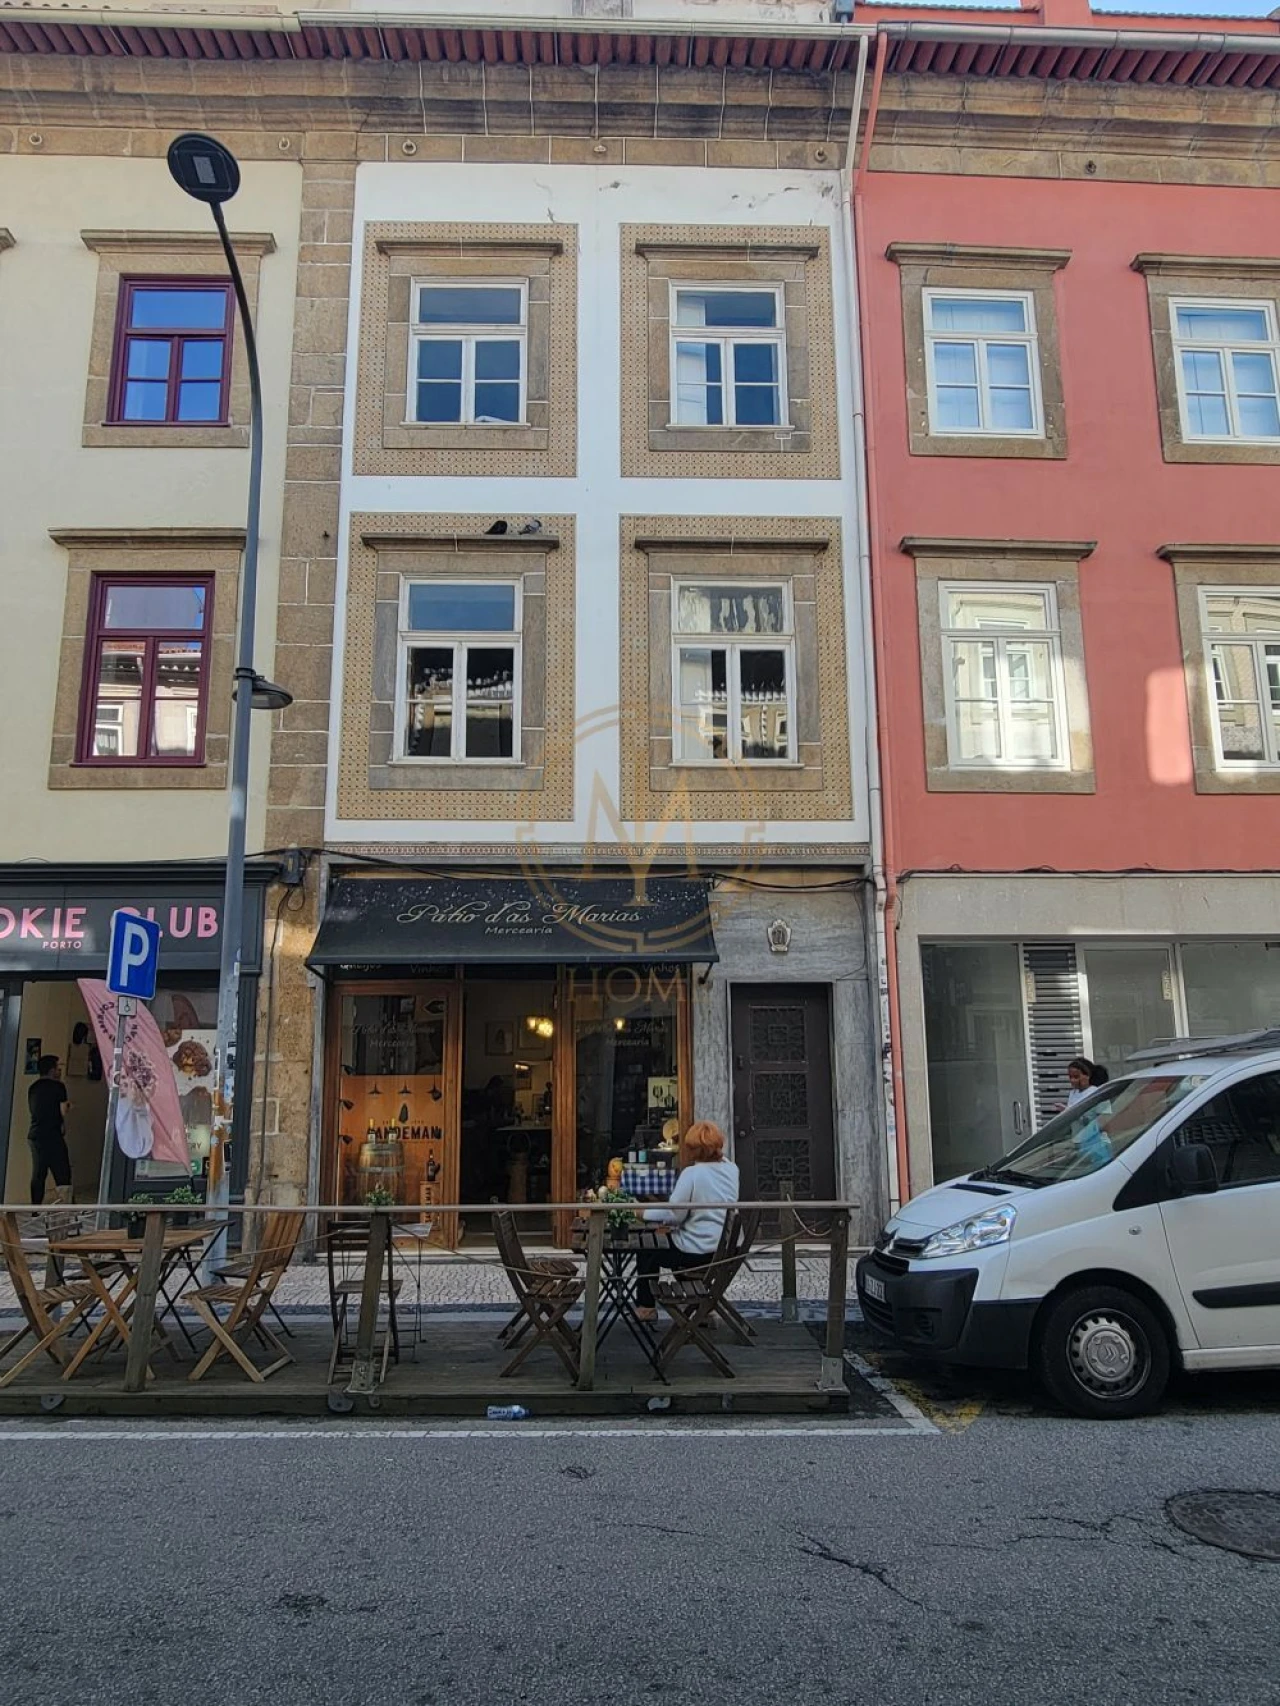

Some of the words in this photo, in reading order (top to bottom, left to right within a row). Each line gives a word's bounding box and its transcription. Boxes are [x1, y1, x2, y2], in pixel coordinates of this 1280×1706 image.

[542, 903, 643, 924] Marias
[485, 926, 554, 934] Mercearia
[42, 941, 82, 949] PORTO
[119, 921, 150, 987] P
